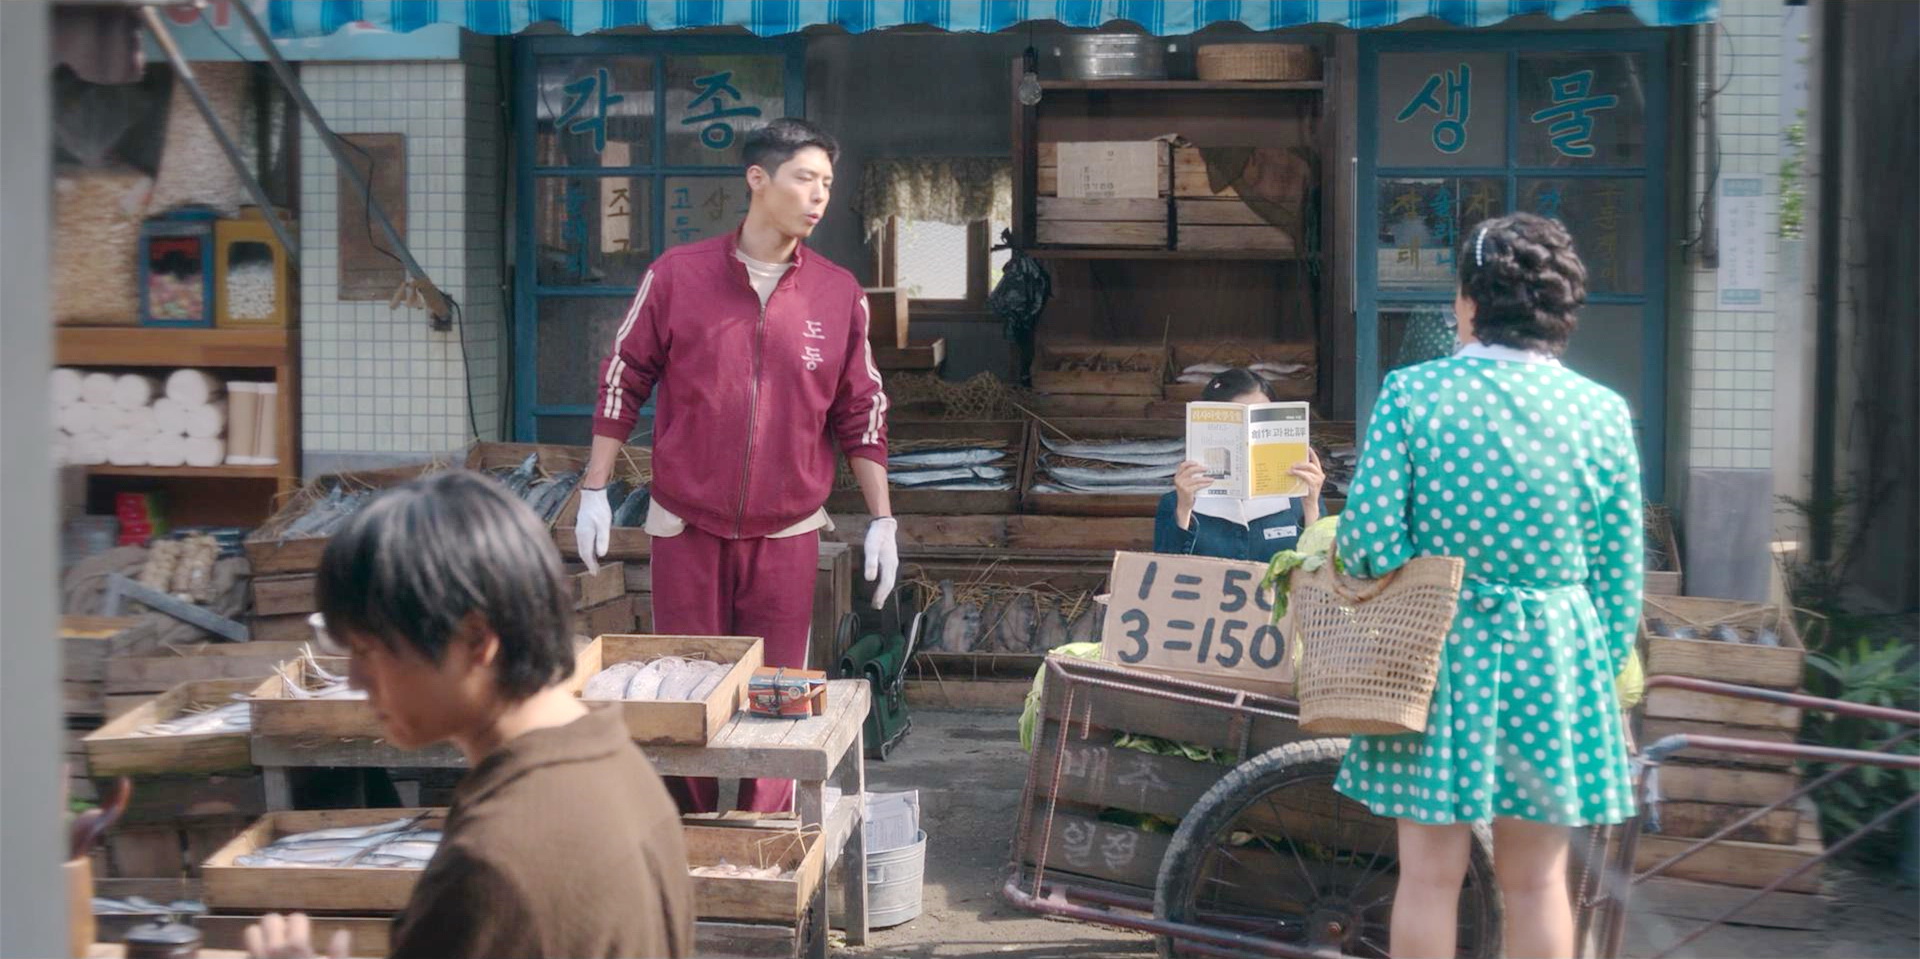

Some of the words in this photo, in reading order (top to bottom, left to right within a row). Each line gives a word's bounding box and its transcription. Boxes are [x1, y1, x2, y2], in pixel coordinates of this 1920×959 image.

[801, 319, 828, 371] 도동
[1138, 561, 1158, 600] 1
[1118, 608, 1150, 663] 3
